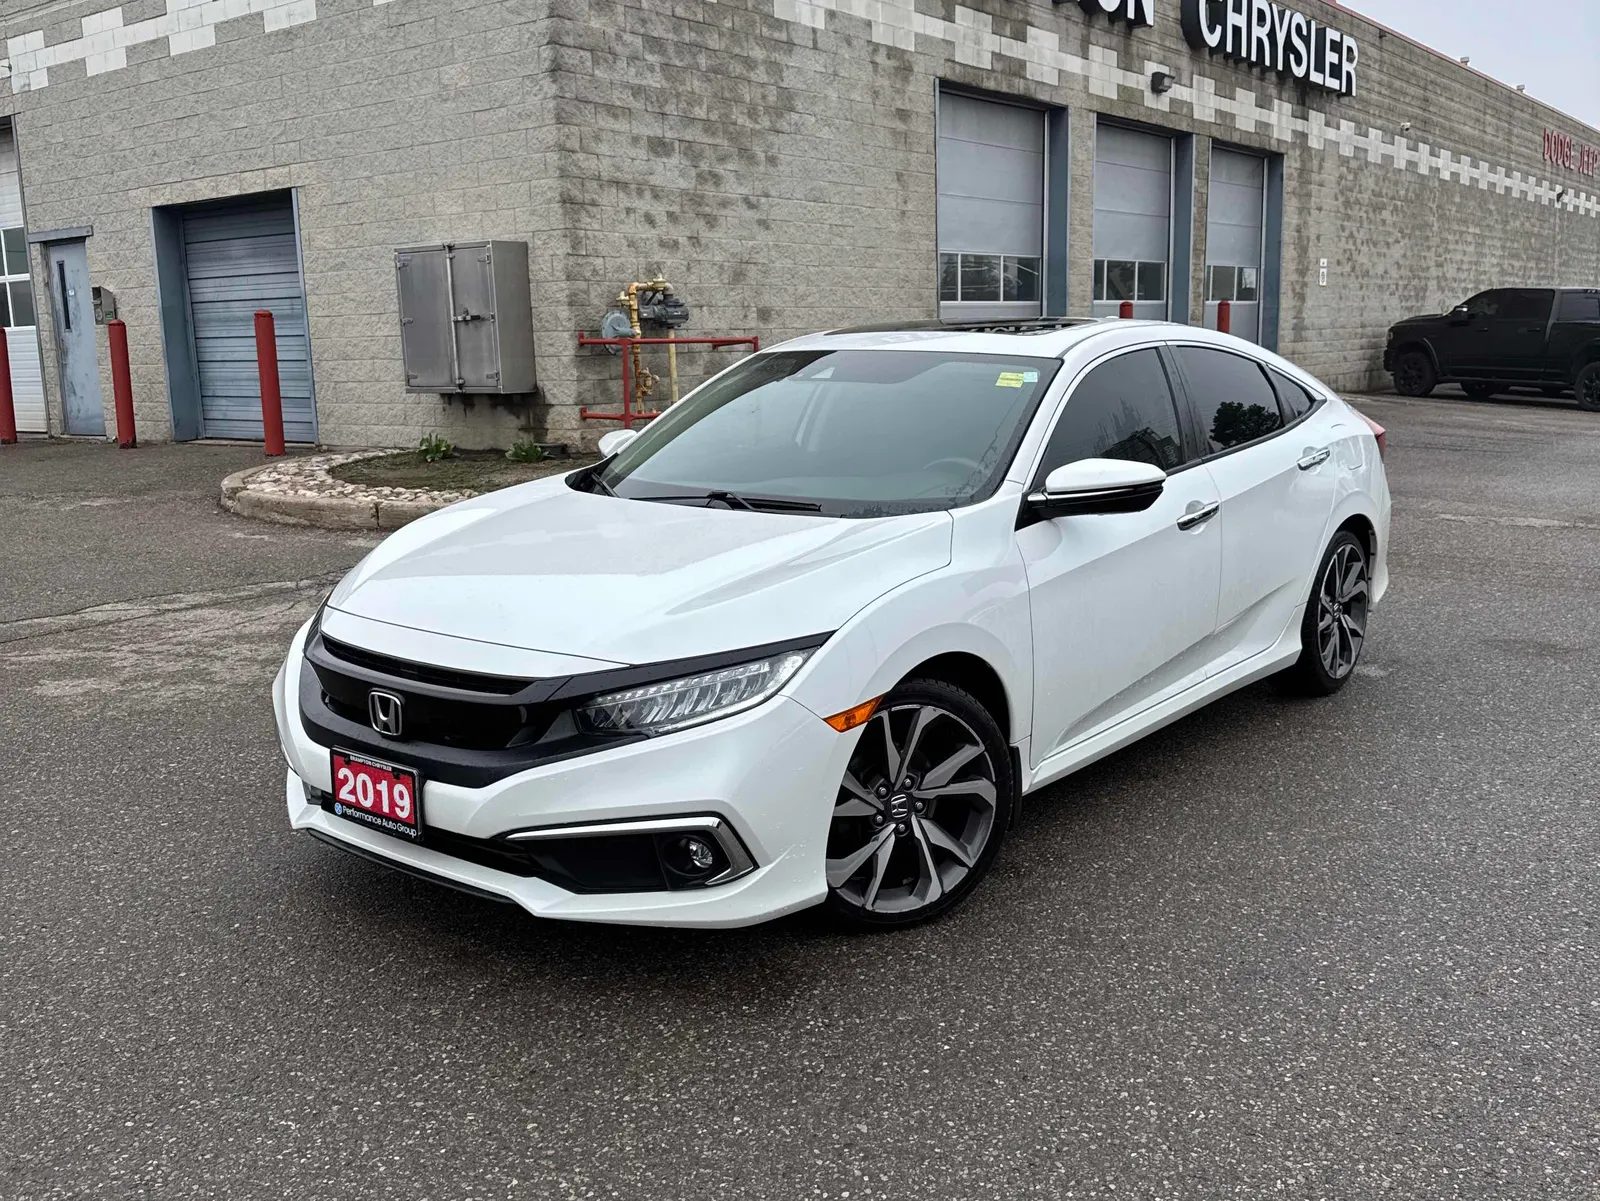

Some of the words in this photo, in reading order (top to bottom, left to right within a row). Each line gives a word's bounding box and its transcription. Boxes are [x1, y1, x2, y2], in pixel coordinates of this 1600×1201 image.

[1199, 0, 1358, 97] CHRYSLER
[1543, 128, 1575, 170] DODGE
[338, 767, 411, 819] 2019
[343, 805, 381, 825] Performance
[382, 818, 397, 830] Auto
[397, 823, 417, 838] Group
